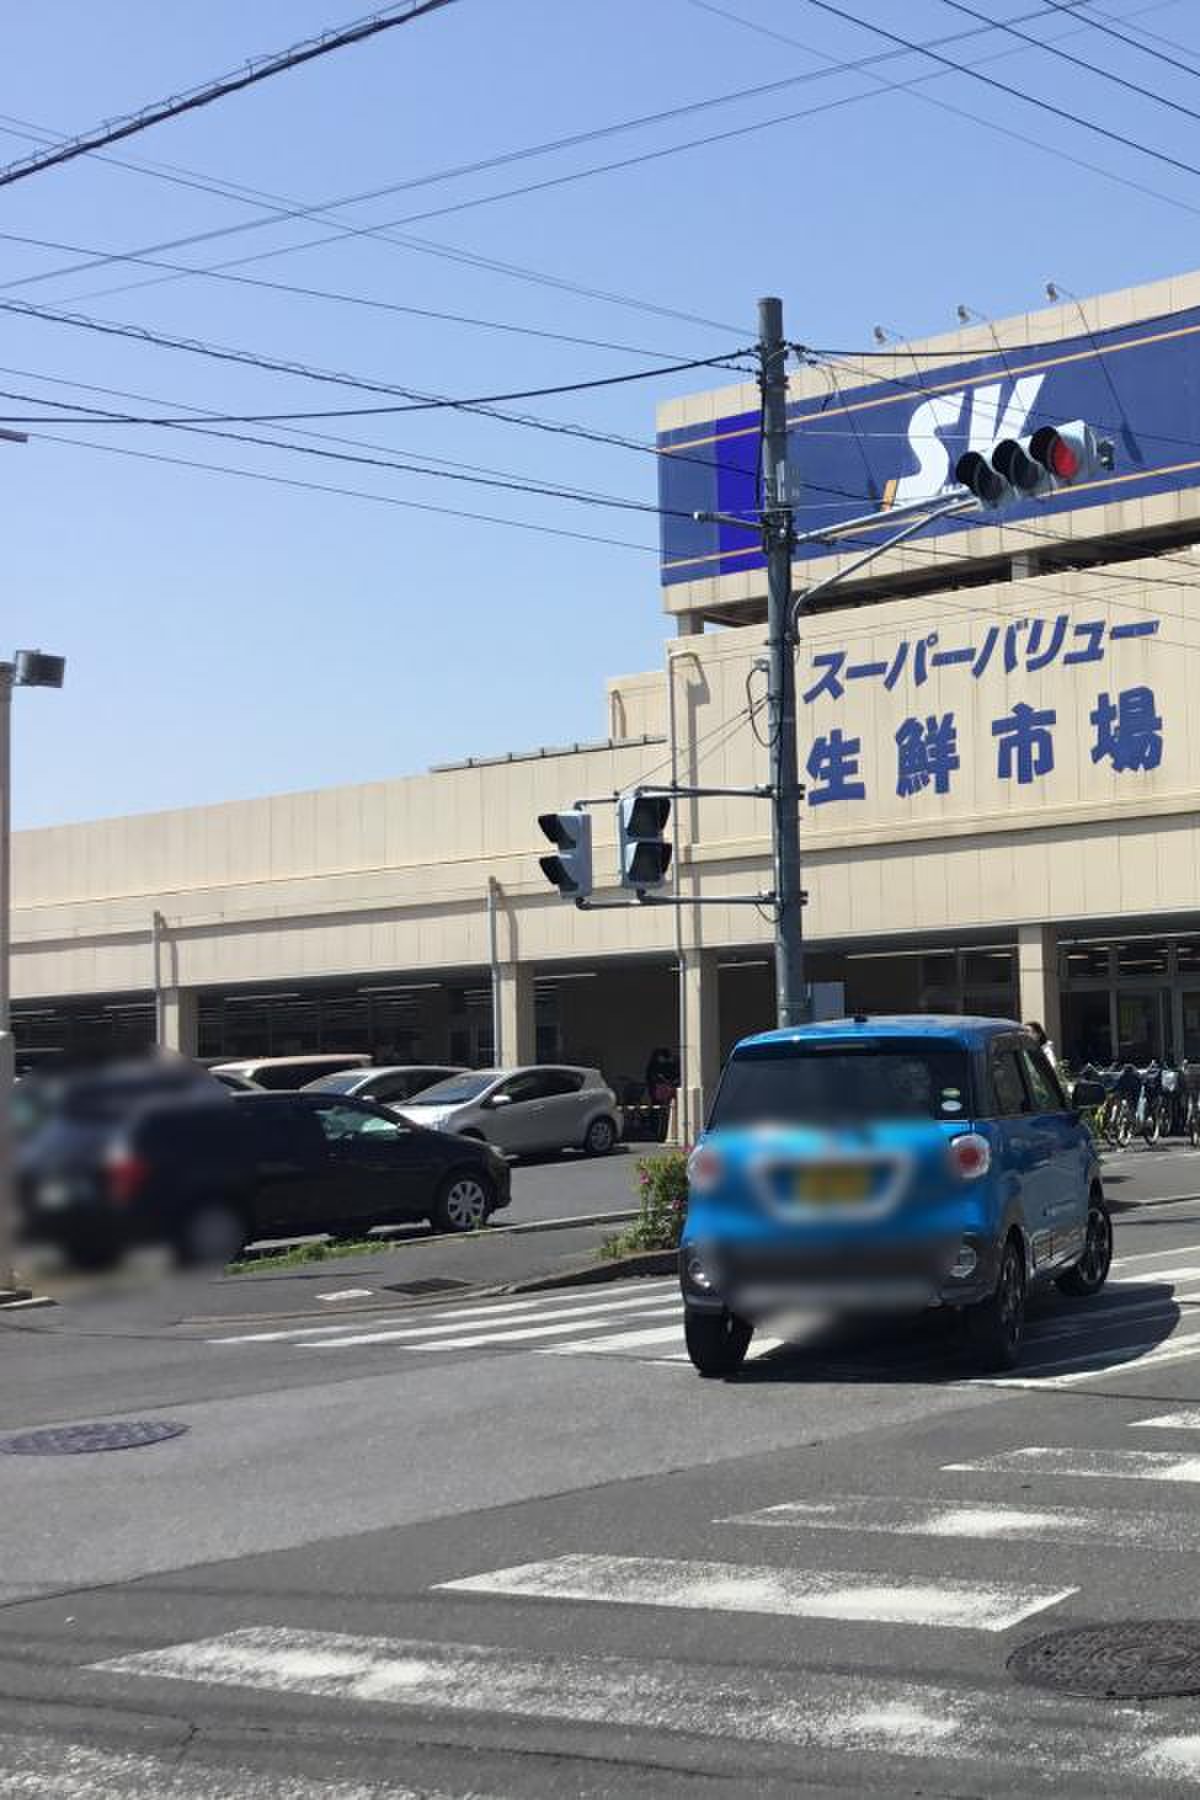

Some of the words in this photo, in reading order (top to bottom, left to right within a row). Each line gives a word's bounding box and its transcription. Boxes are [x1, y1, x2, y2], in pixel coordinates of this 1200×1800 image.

[803, 615, 1160, 704] スーパーバリュー
[806, 687, 1162, 806] 生鮮市場
